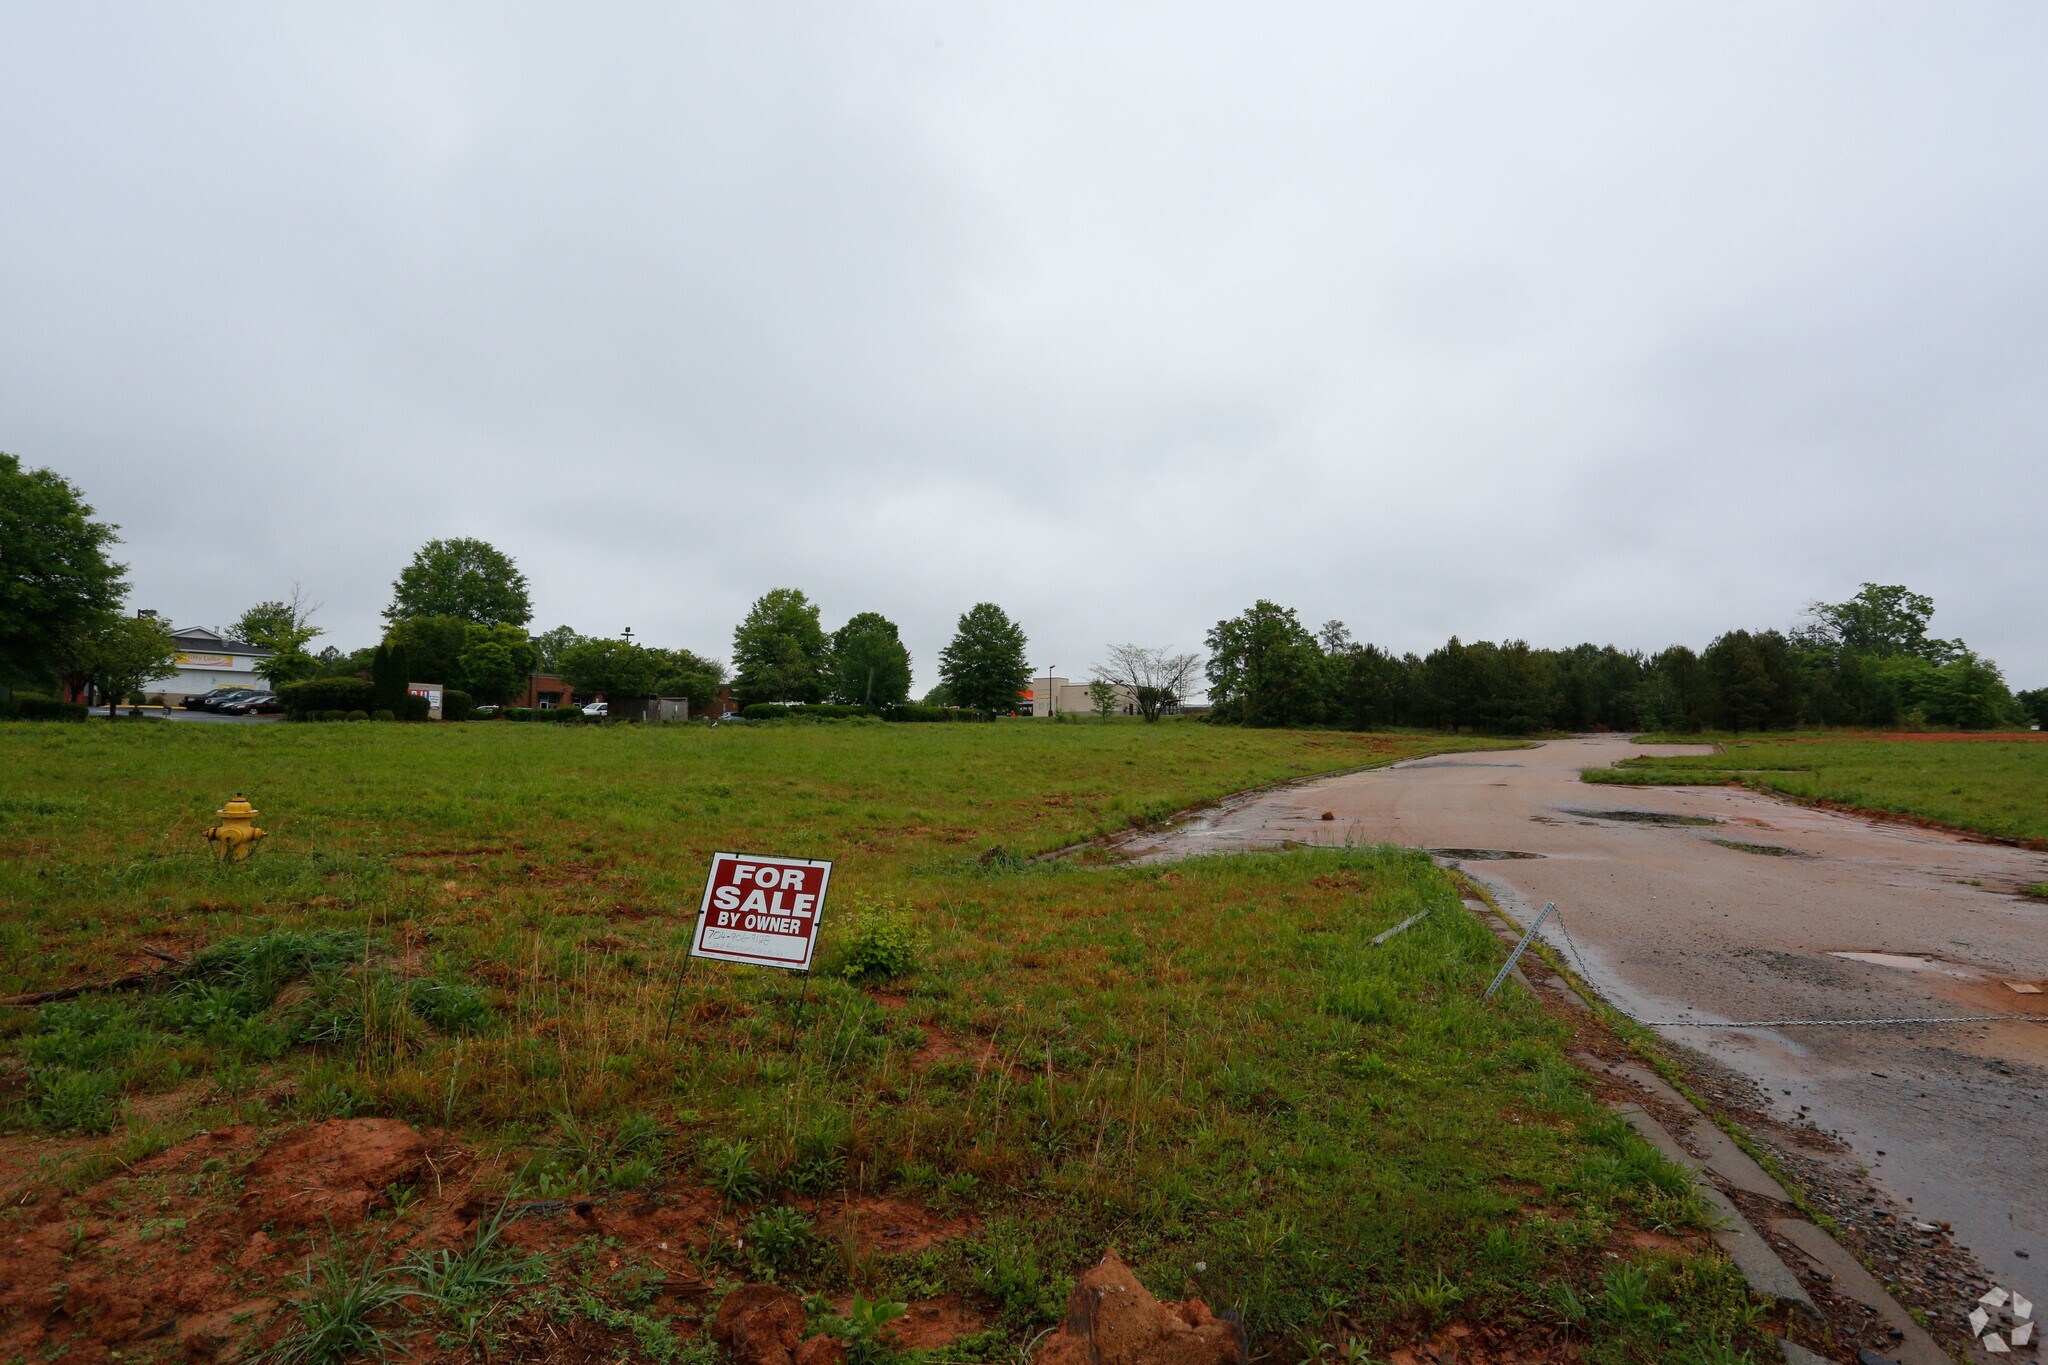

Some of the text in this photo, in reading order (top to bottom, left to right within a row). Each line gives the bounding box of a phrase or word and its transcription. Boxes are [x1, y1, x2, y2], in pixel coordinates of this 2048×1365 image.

[733, 865, 805, 890] FOR
[714, 886, 815, 918] SALE
[717, 911, 801, 934] BY OWNER
